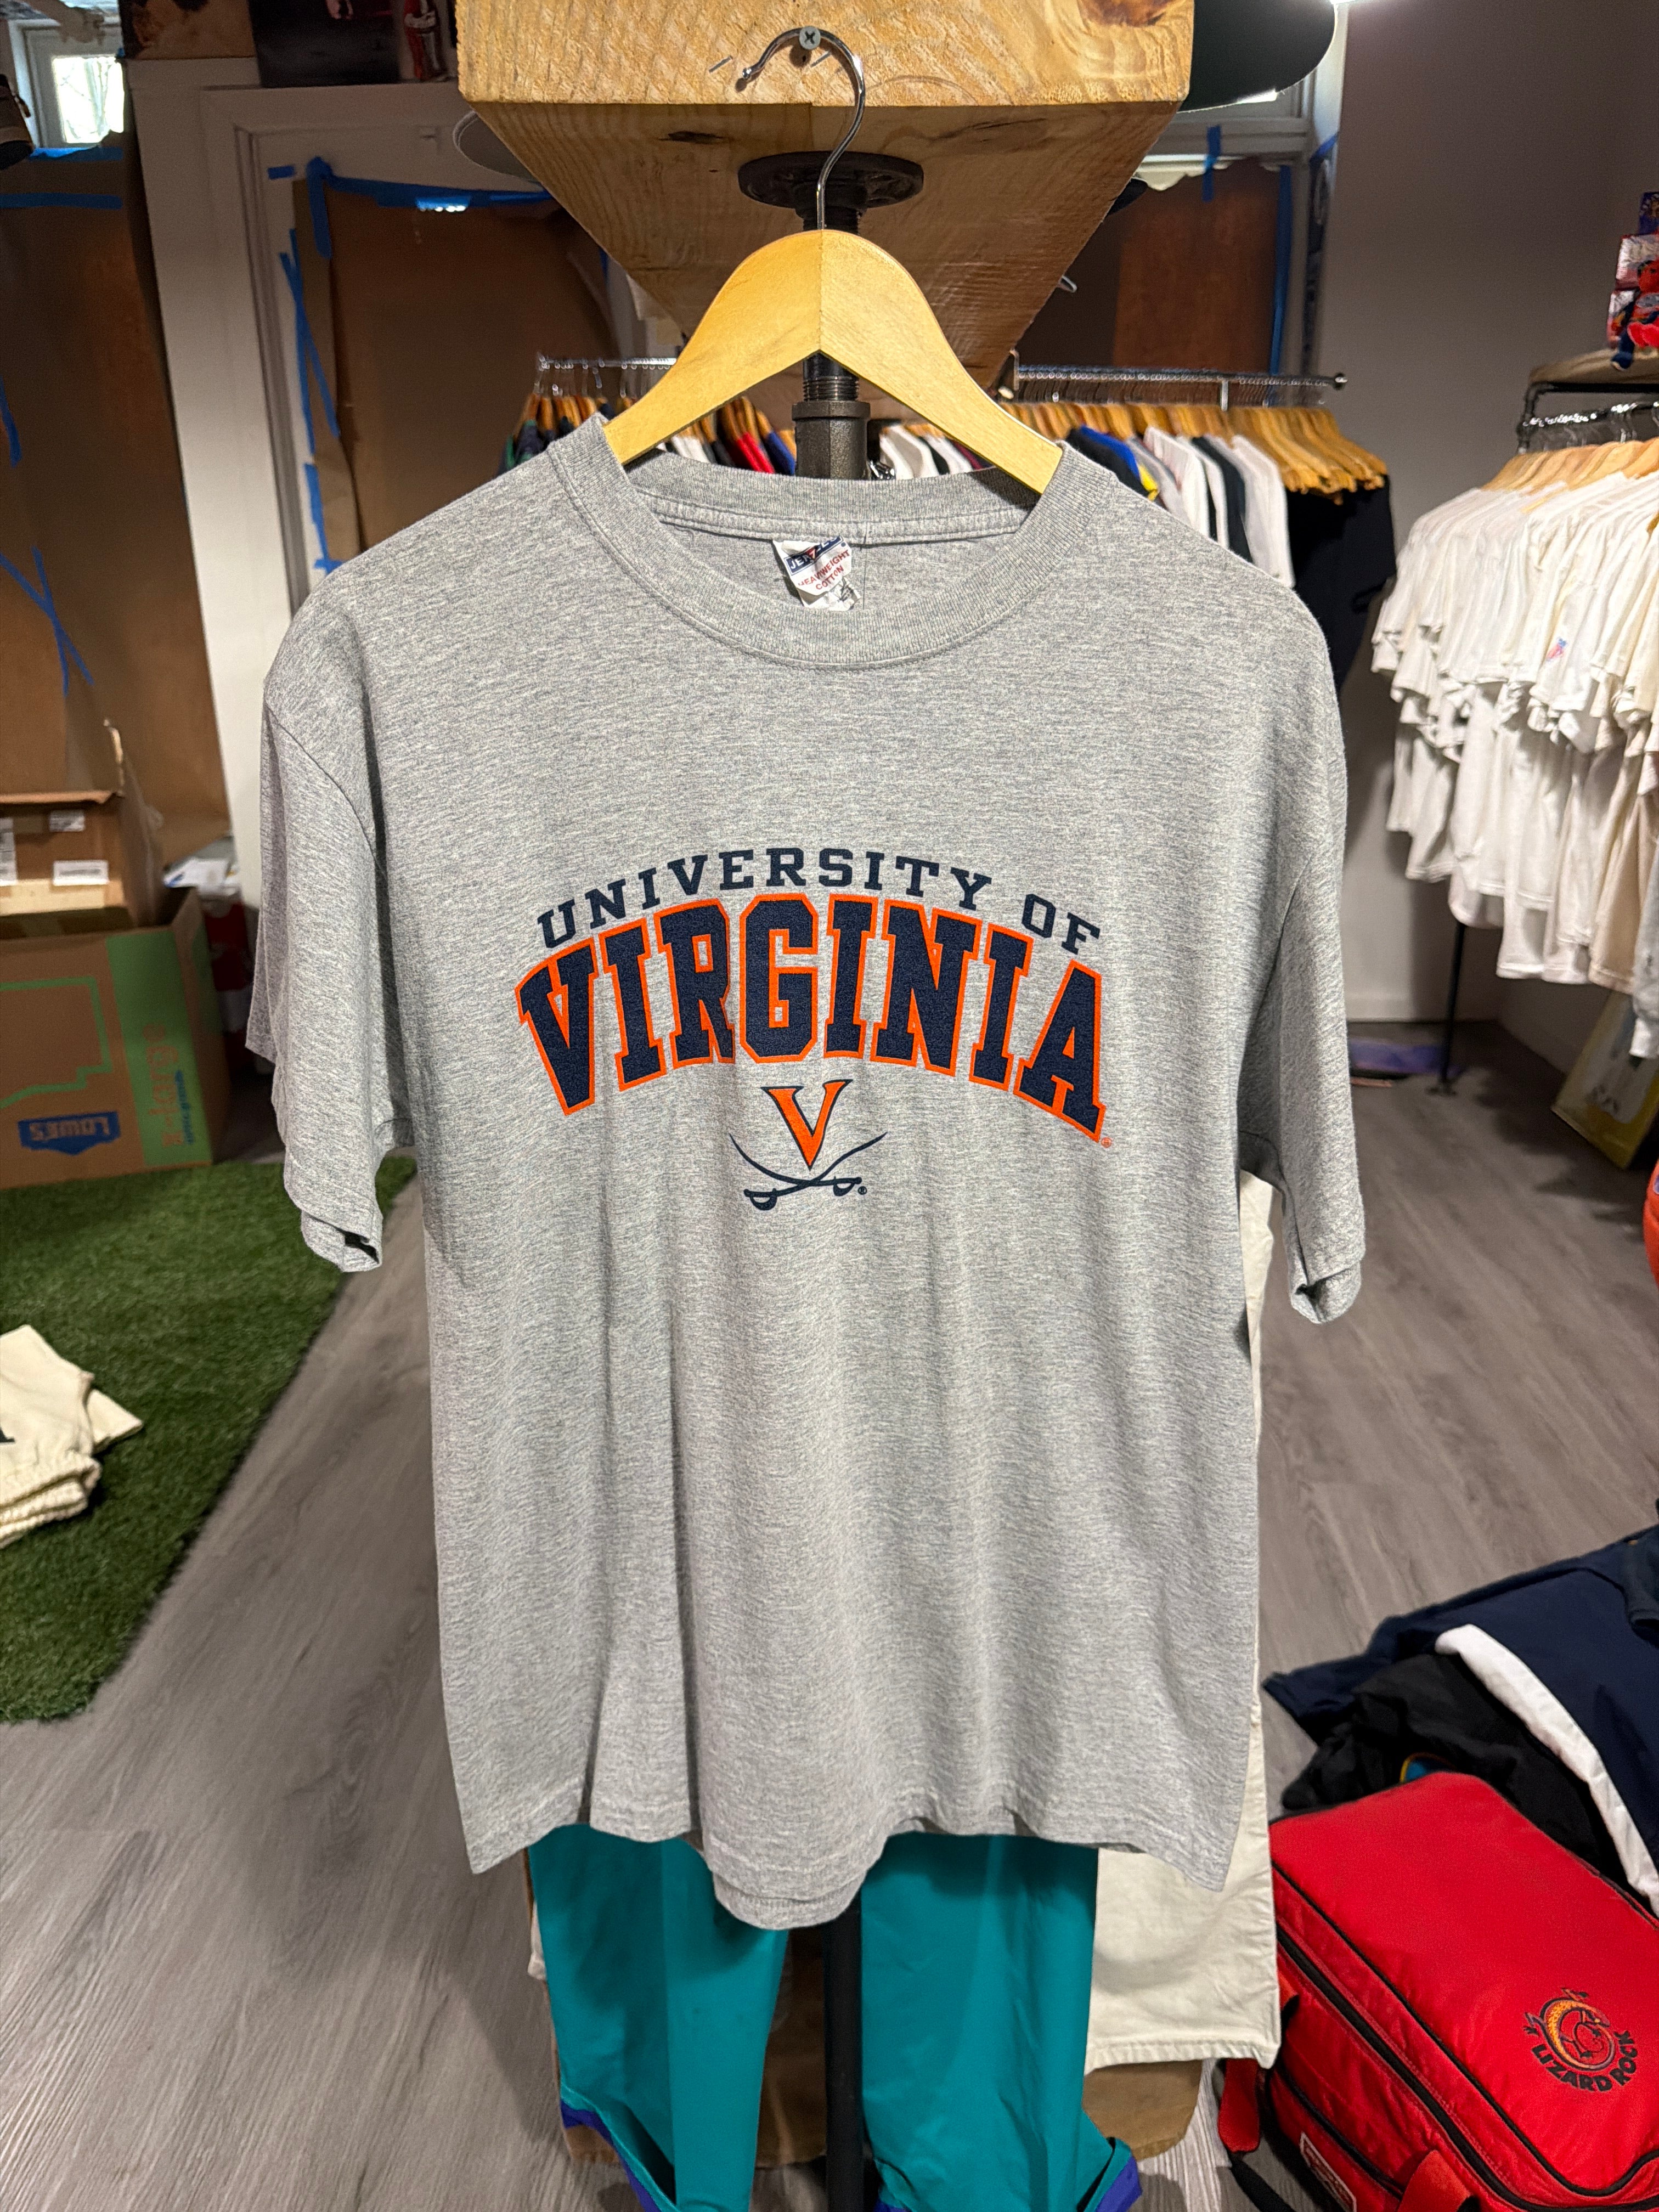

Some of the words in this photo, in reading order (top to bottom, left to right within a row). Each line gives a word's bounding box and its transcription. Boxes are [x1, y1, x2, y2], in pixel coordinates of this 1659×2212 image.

[816, 565, 844, 590] COTTON
[537, 847, 992, 949] UNIVERSITY
[1022, 894, 1101, 955] OF
[514, 893, 1106, 1143] VIRGINIA
[760, 1079, 854, 1171] V
[1531, 2044, 1613, 2093] LIZARD
[1609, 2029, 1638, 2086] ROCK
